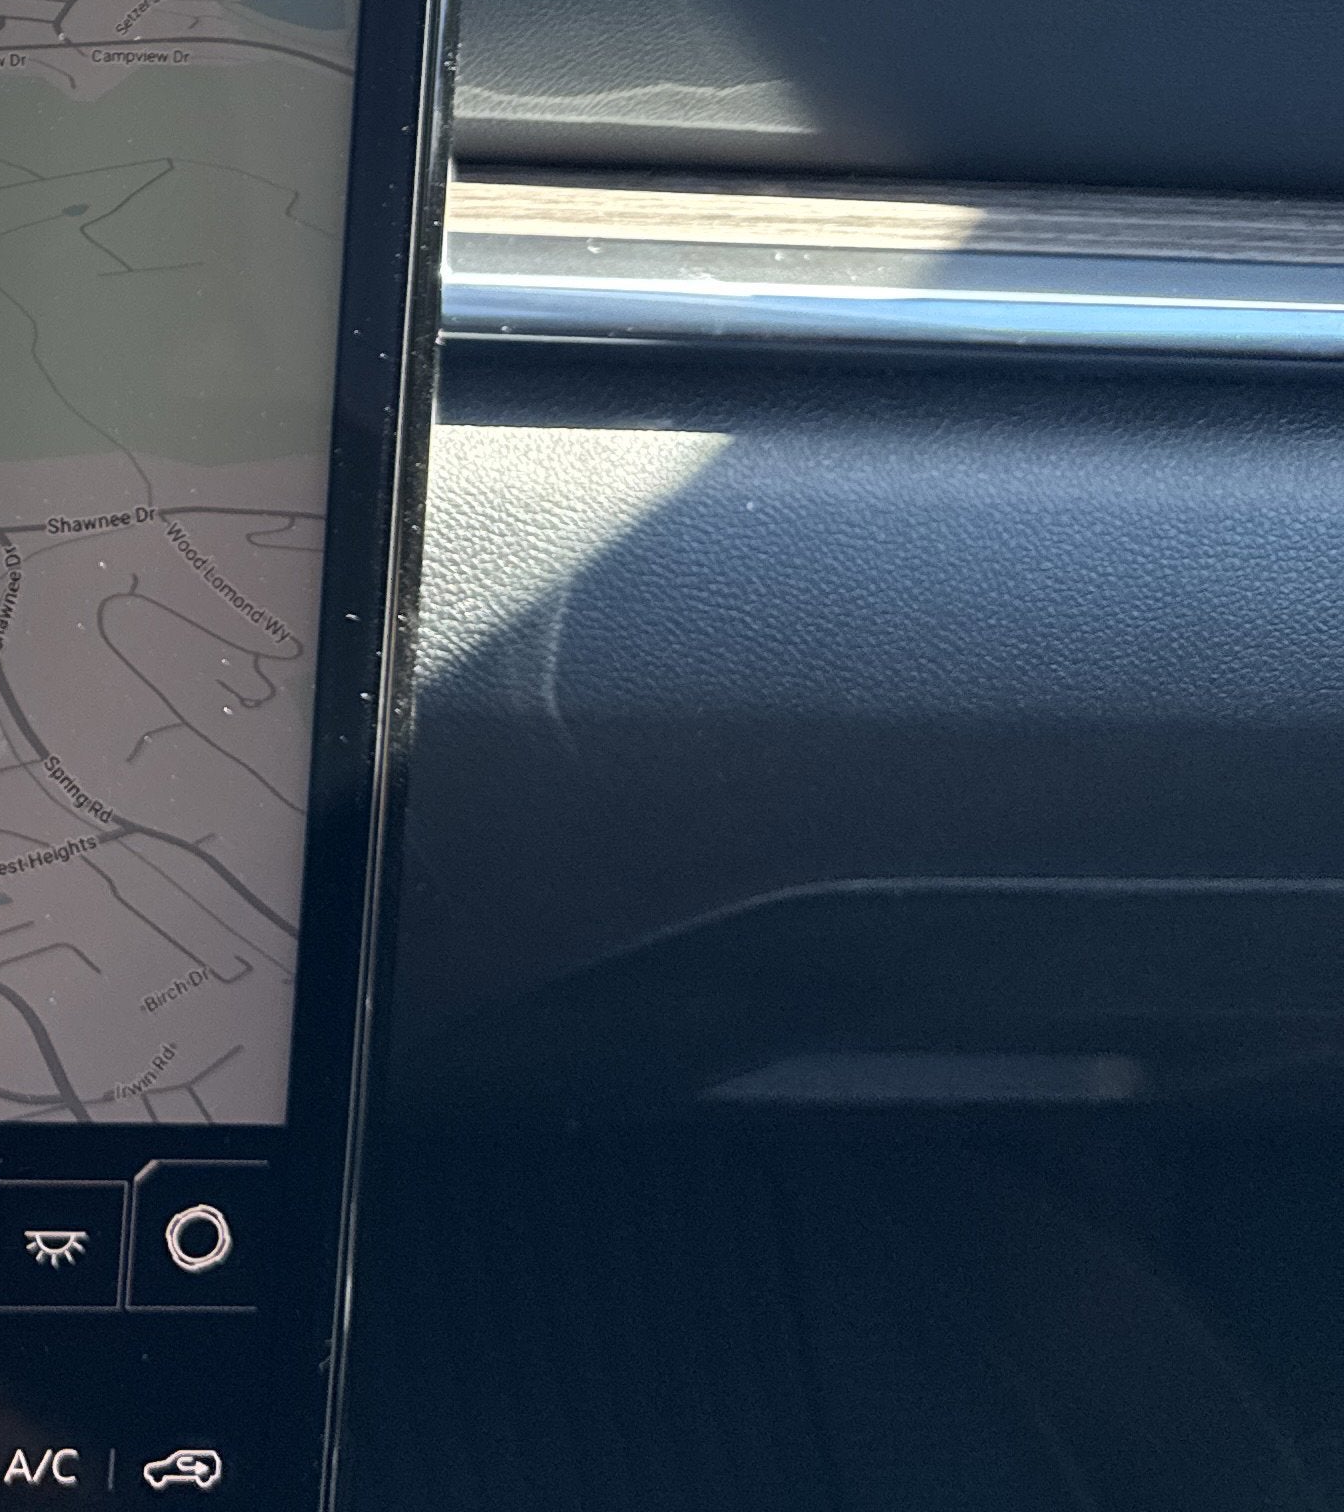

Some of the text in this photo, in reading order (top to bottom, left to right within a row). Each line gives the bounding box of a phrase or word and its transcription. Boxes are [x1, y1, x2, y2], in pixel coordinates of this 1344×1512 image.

[116, 0, 154, 35] Setzer
[6, 55, 26, 67] Dr
[92, 49, 189, 64] Campview Dr
[47, 507, 156, 534] Shawnee Dr
[166, 522, 290, 642] Wood Lomond Wy
[44, 755, 114, 824] Spring Rd
[28, 837, 97, 870] Heights
[144, 967, 209, 1012] Birch Dr
[5, 1449, 79, 1485] A/C
